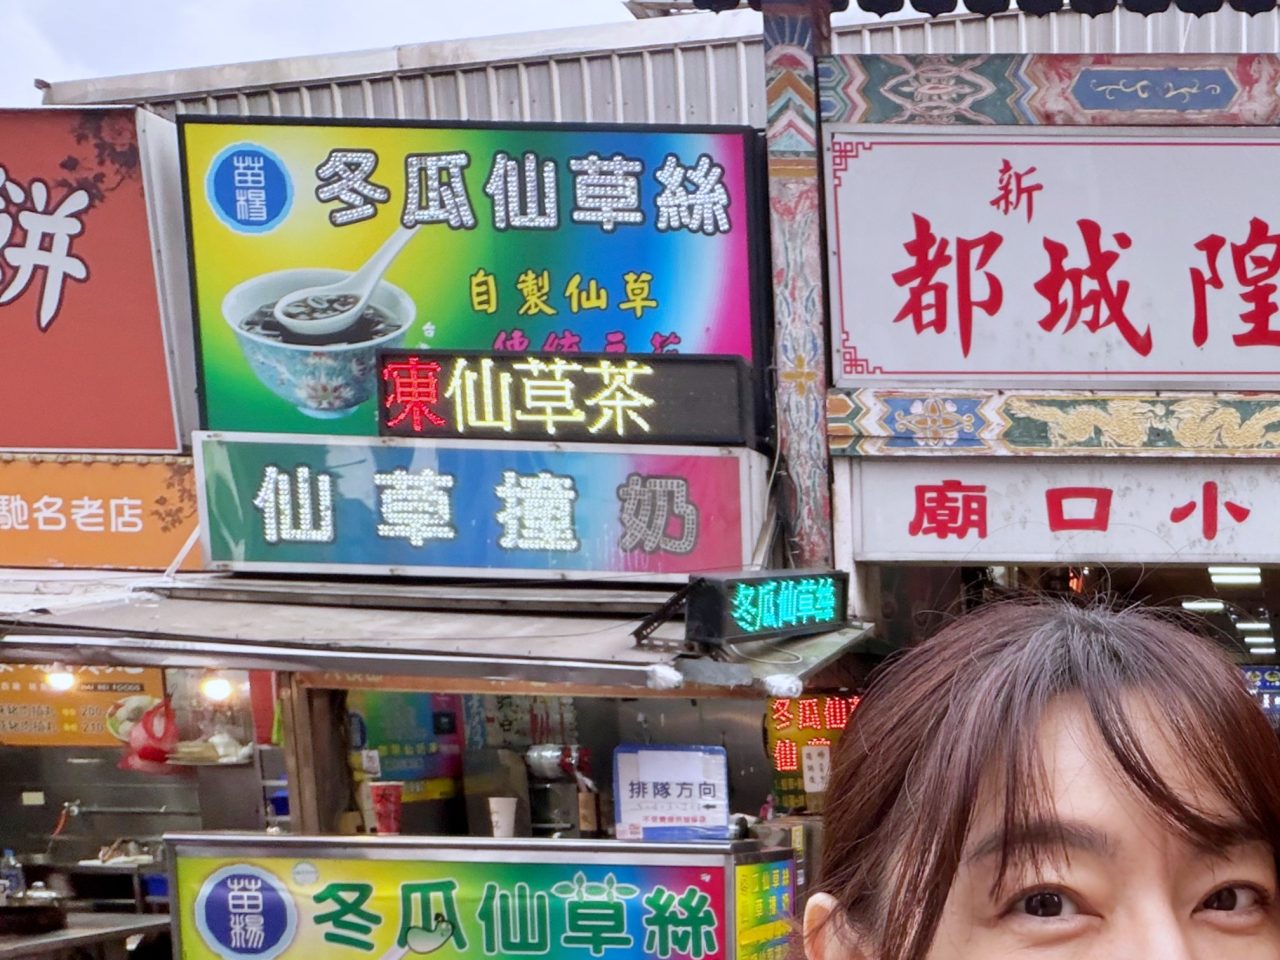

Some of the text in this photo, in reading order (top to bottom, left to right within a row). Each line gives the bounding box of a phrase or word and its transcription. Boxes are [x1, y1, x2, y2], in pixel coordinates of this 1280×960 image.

[315, 150, 732, 236] 冬瓜仙草絲
[470, 269, 658, 317] 自製仙草
[254, 465, 698, 554] 仙草撞奶
[629, 780, 716, 799] 排隊方向
[312, 872, 718, 960] 冬瓜仙草絲
